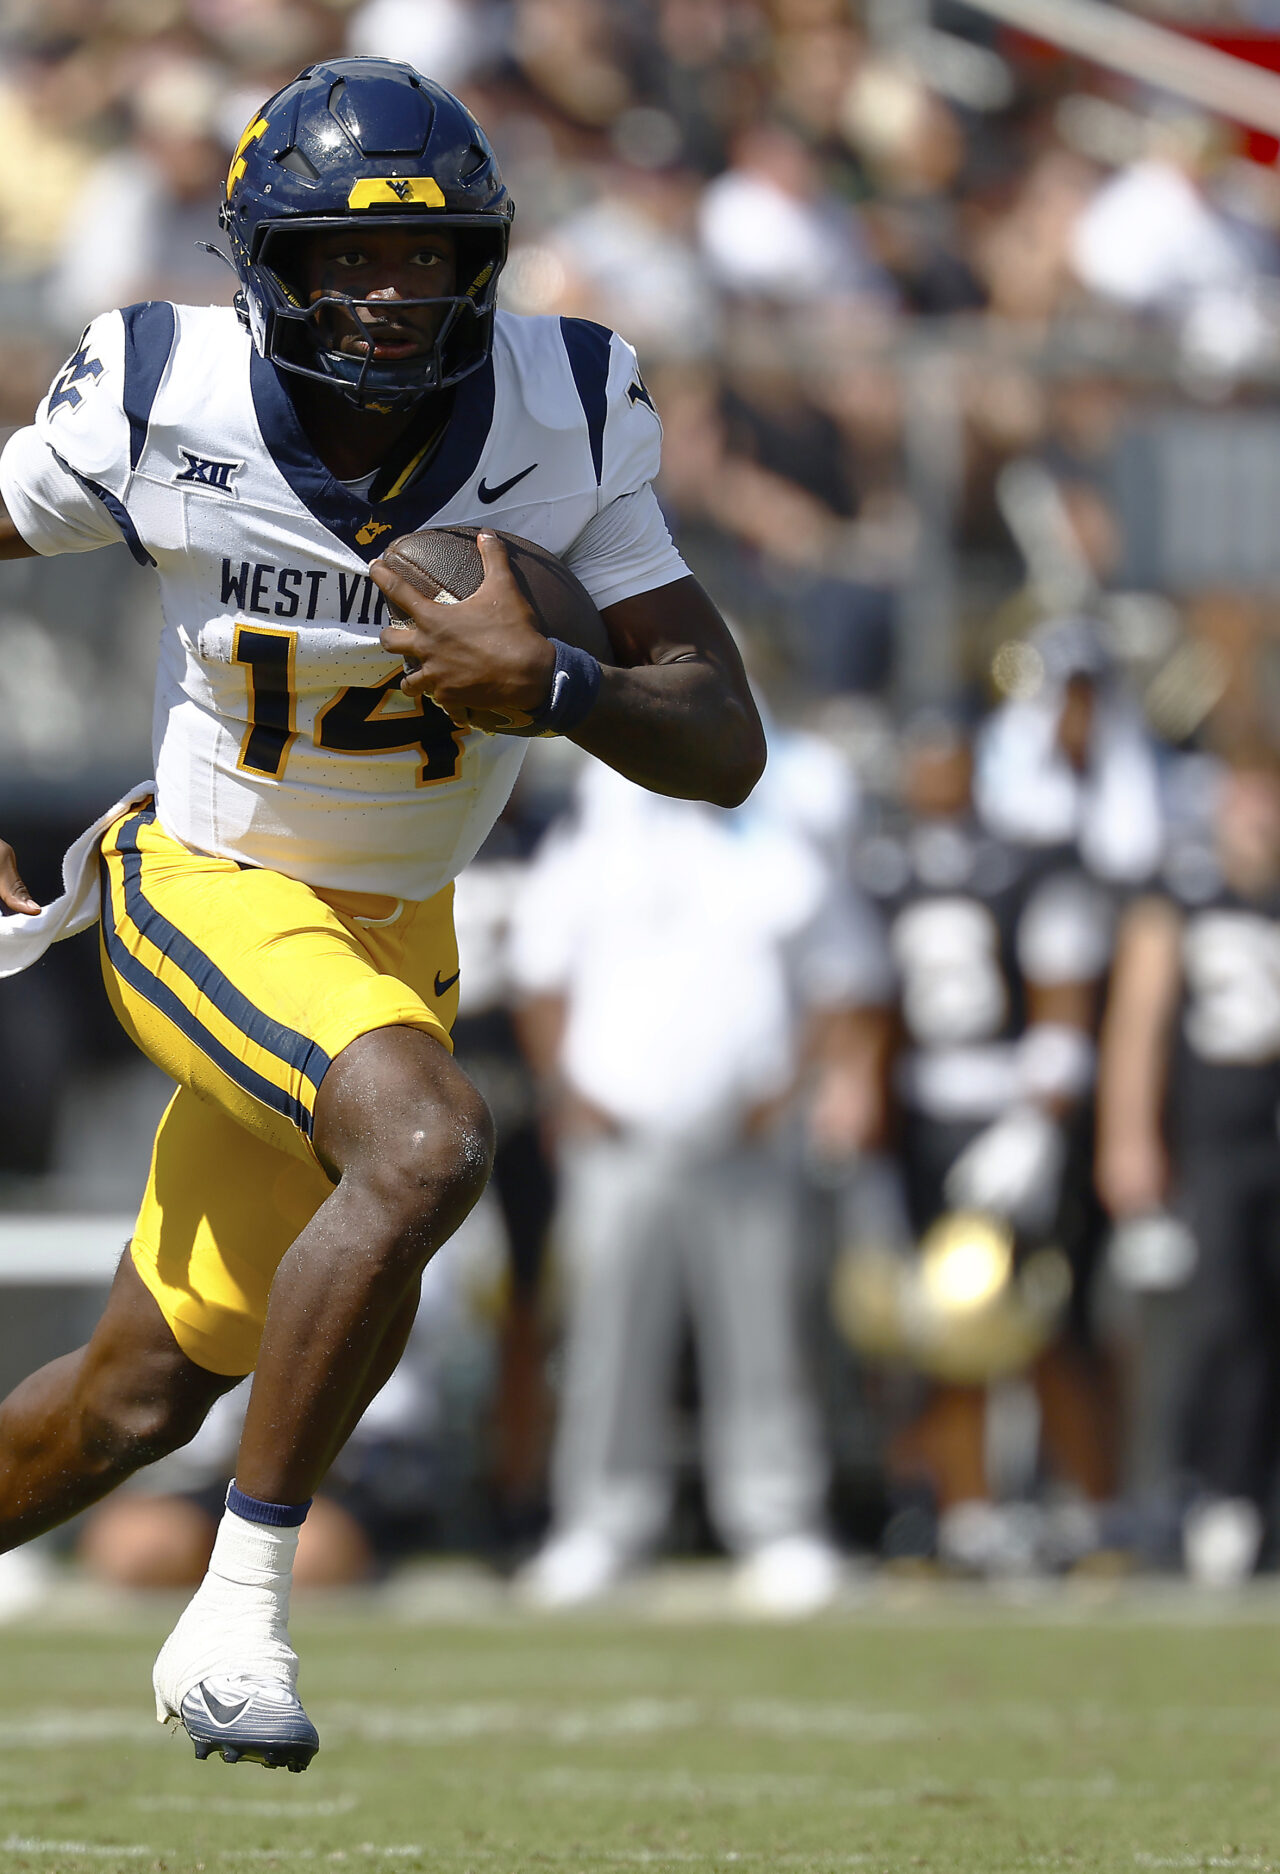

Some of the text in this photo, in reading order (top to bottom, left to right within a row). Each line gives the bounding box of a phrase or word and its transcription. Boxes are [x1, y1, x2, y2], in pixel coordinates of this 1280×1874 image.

[175, 449, 242, 496] XII
[220, 558, 328, 620] WEST
[230, 622, 471, 788] 14
